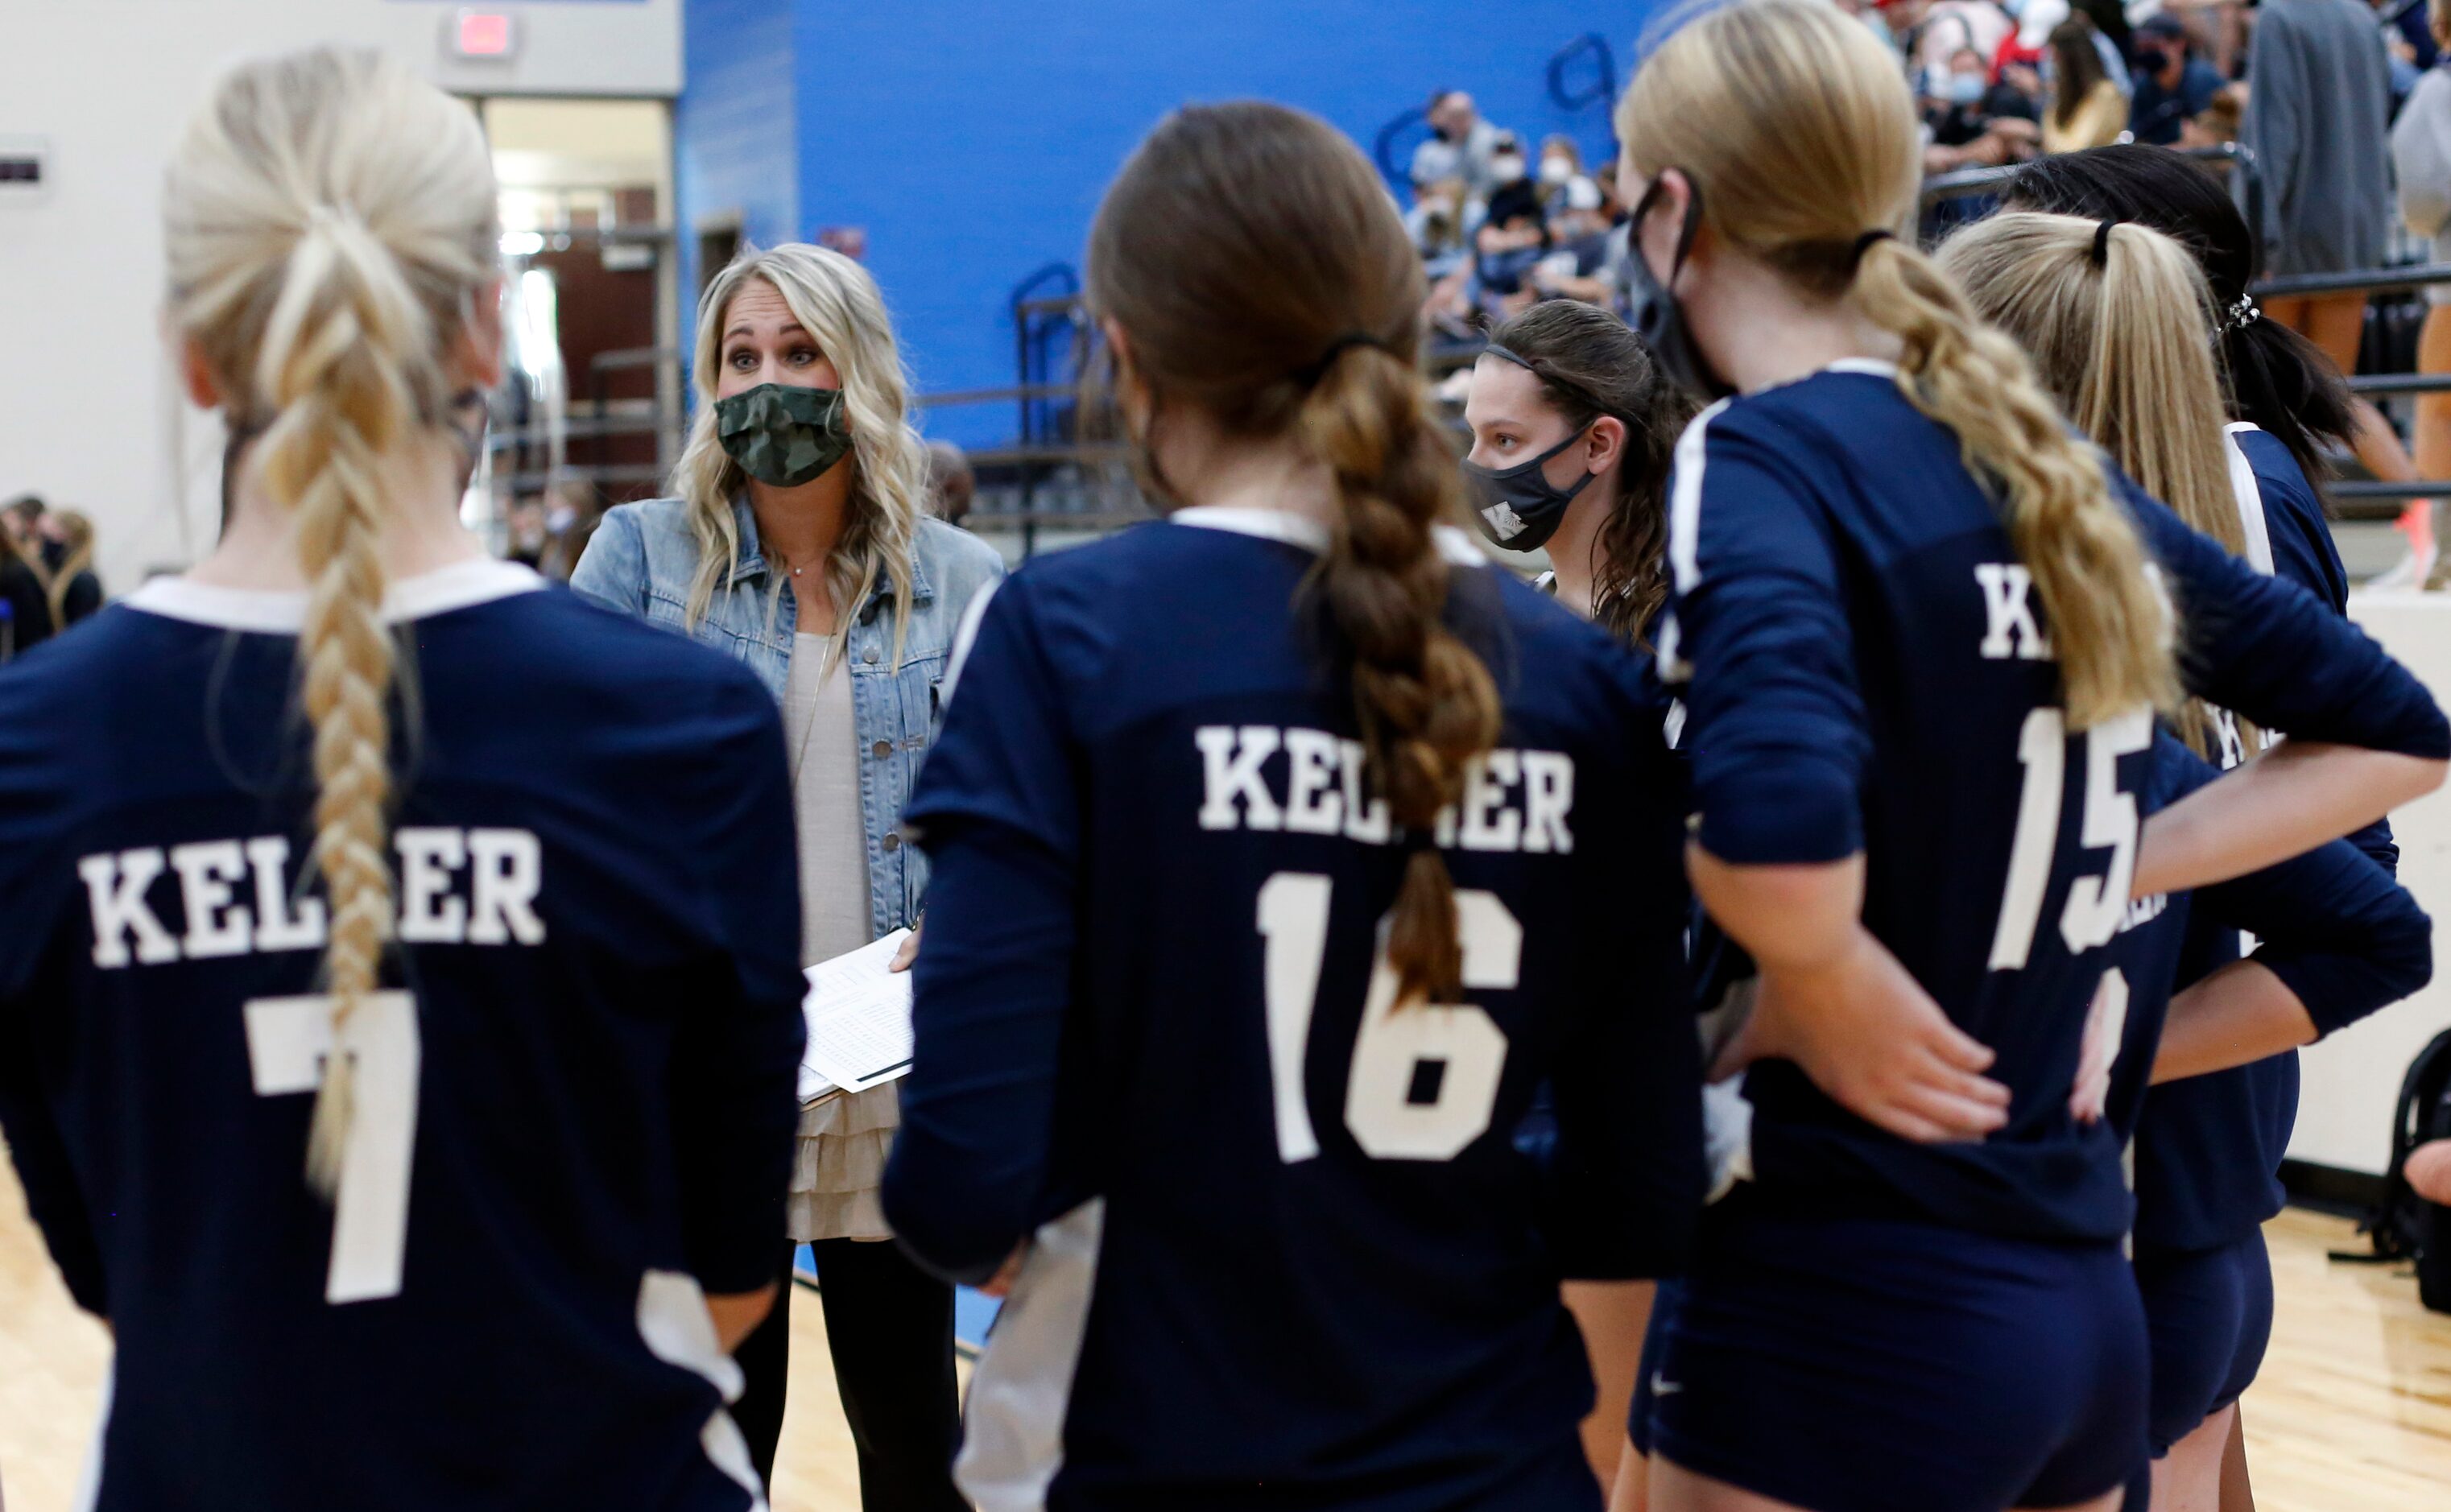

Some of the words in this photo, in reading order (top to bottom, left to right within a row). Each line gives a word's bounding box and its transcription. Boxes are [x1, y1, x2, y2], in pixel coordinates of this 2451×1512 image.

[78, 827, 547, 969] KELER
[1195, 725, 1575, 855] KELER
[1986, 704, 2154, 971] 15
[244, 988, 422, 1305] 7
[1256, 871, 1524, 1164] 16
